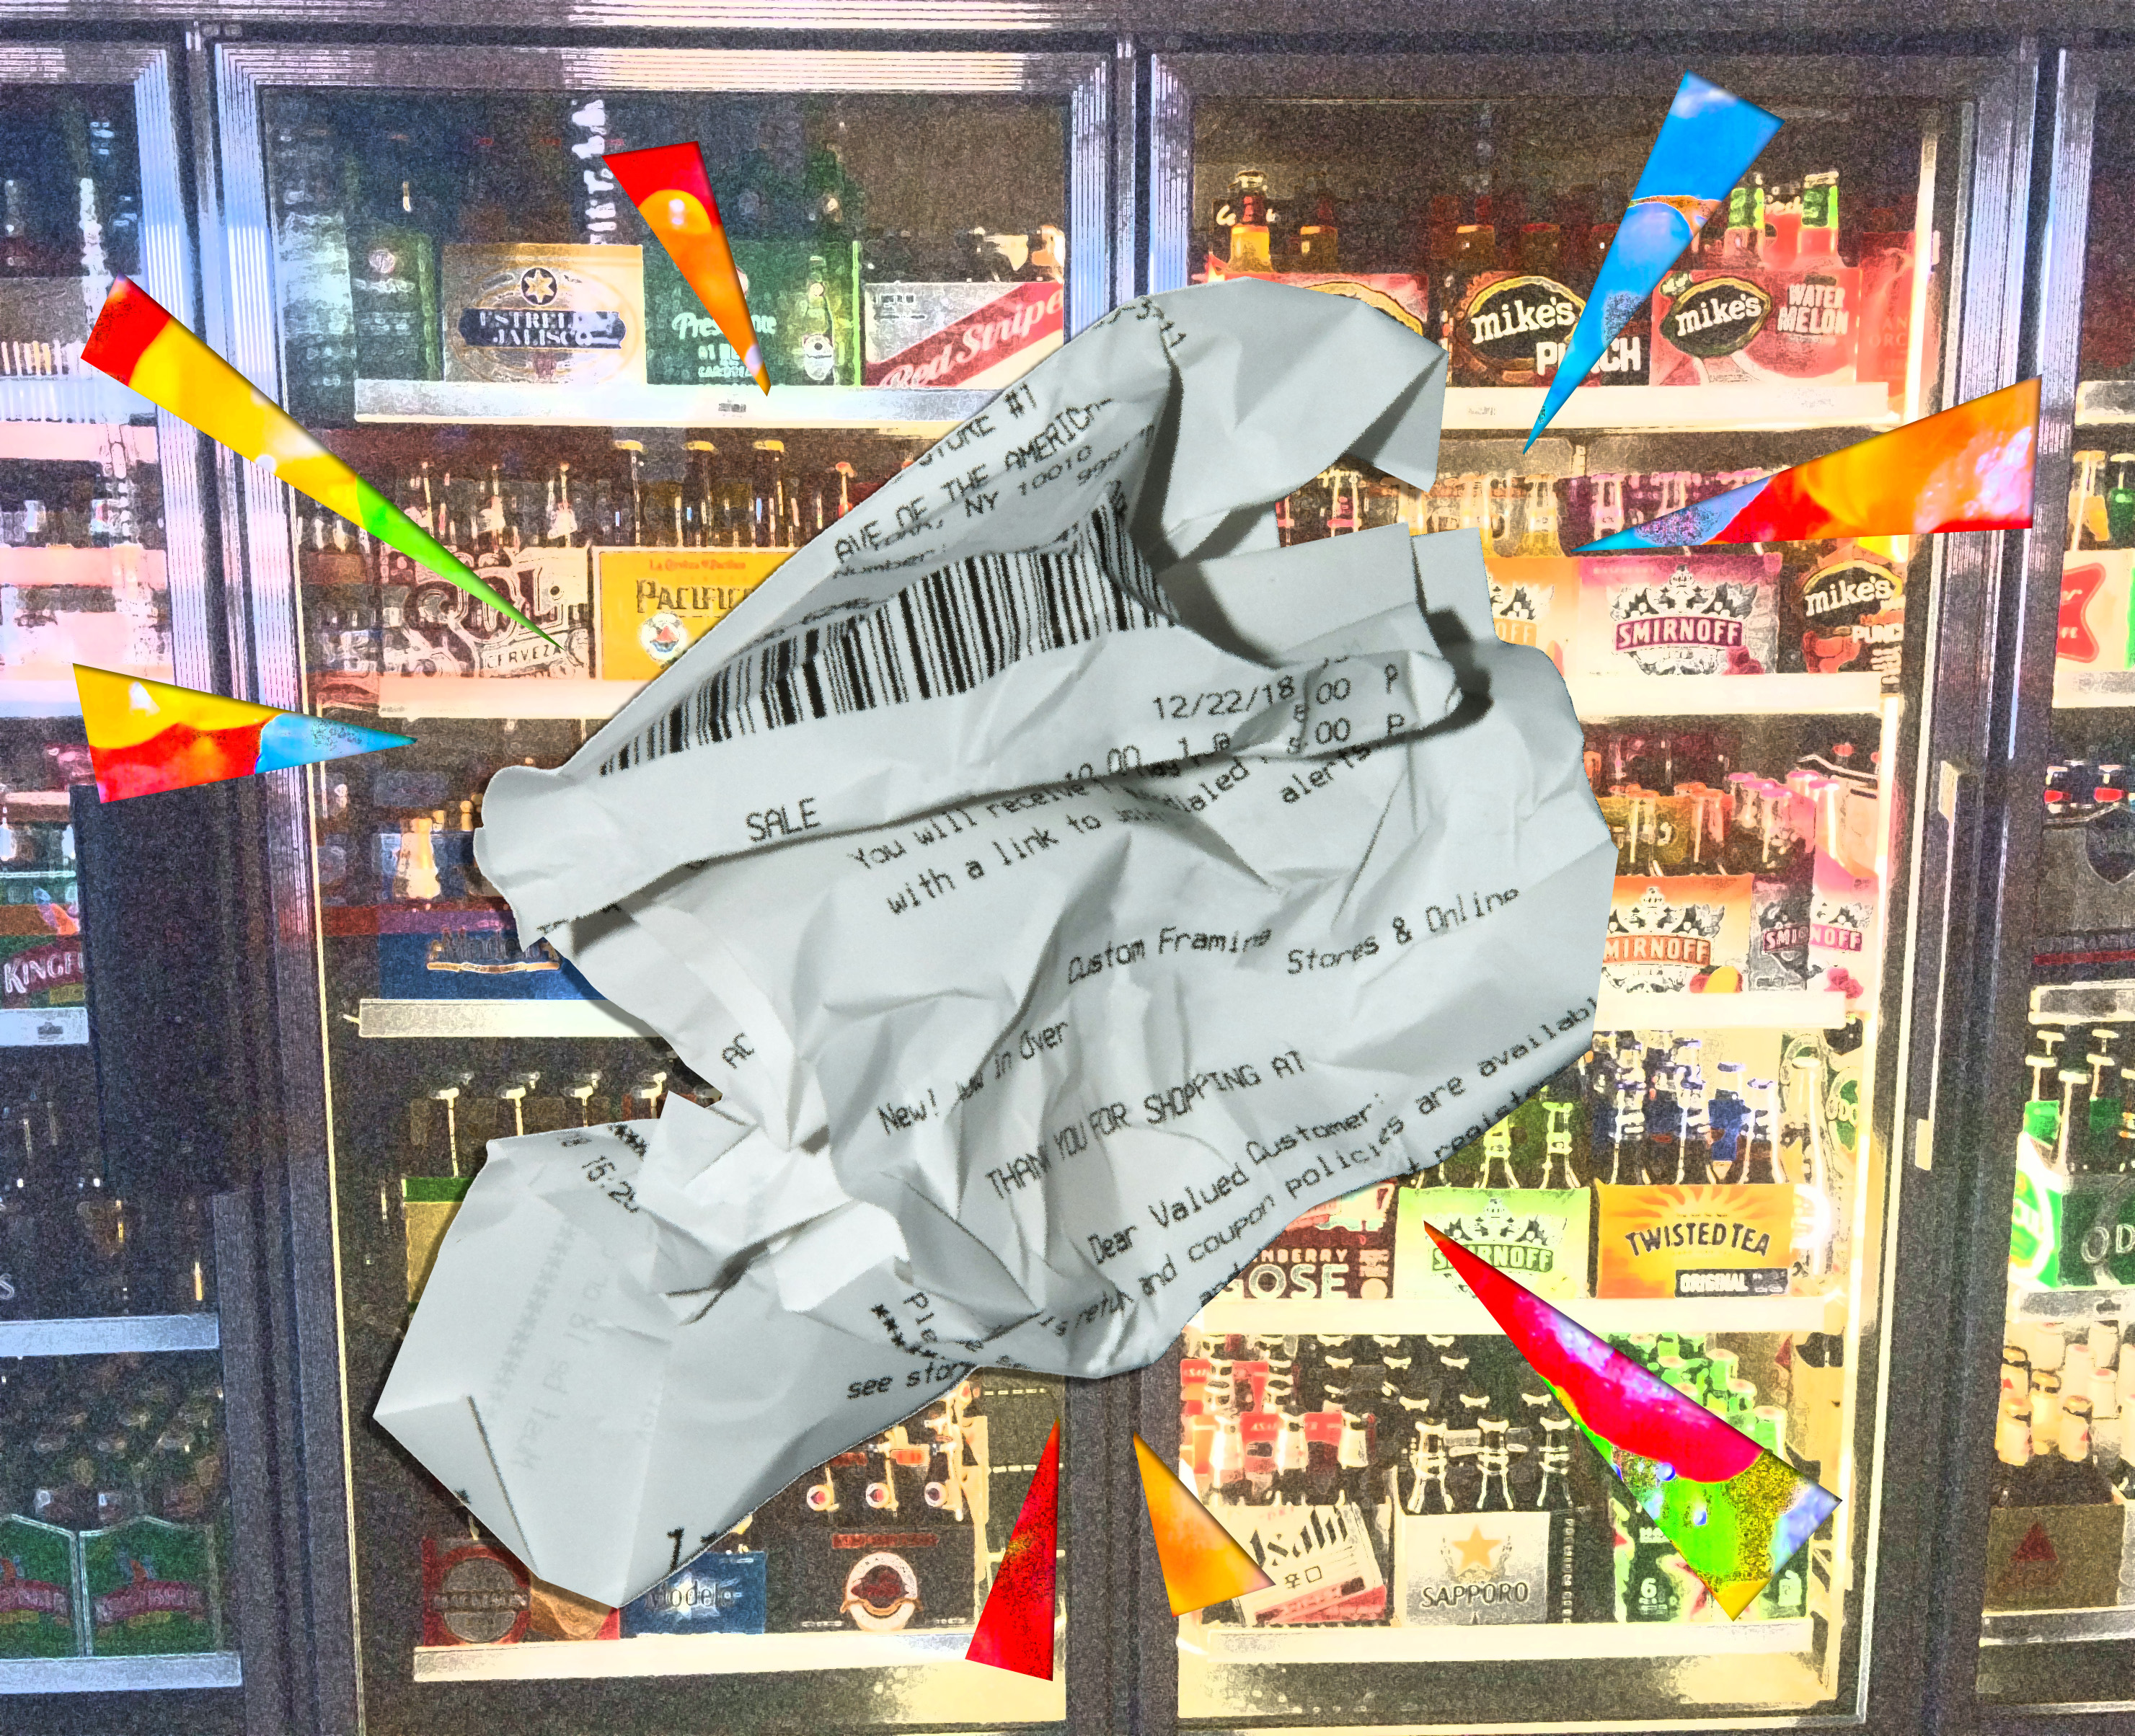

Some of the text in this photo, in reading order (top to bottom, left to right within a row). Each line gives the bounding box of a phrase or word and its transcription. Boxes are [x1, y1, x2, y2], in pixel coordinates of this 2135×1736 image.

[1788, 283, 1846, 309] WATER
[671, 312, 777, 340] Presnte
[1471, 296, 1575, 344] mike's
[1675, 293, 1763, 337] mike's
[1777, 306, 1849, 335] MELON
[1536, 336, 1641, 376] PCH
[1805, 576, 1893, 616] mike's
[1618, 618, 1742, 647] SMIRNOFF
[1152, 675, 1296, 719] 12/22/18
[745, 796, 822, 843] SALE
[886, 868, 956, 915] with
[965, 859, 985, 880] a
[991, 826, 1059, 866] link
[1392, 916, 1413, 945] &
[1067, 939, 1146, 986] Custom
[1602, 937, 1712, 964] MIRNOFF
[1187, 1194, 1276, 1263] coupon
[1415, 1076, 1466, 1116] are
[1087, 1224, 1139, 1266] Dear
[1147, 1162, 1250, 1229] Valued
[1253, 1248, 1348, 1263] NBERRY
[1625, 1222, 1771, 1257] TWISTED TEA
[1434, 1245, 1552, 1272] SRNOFF
[847, 1375, 893, 1400] see
[1420, 1582, 1529, 1608] SAPPORO
